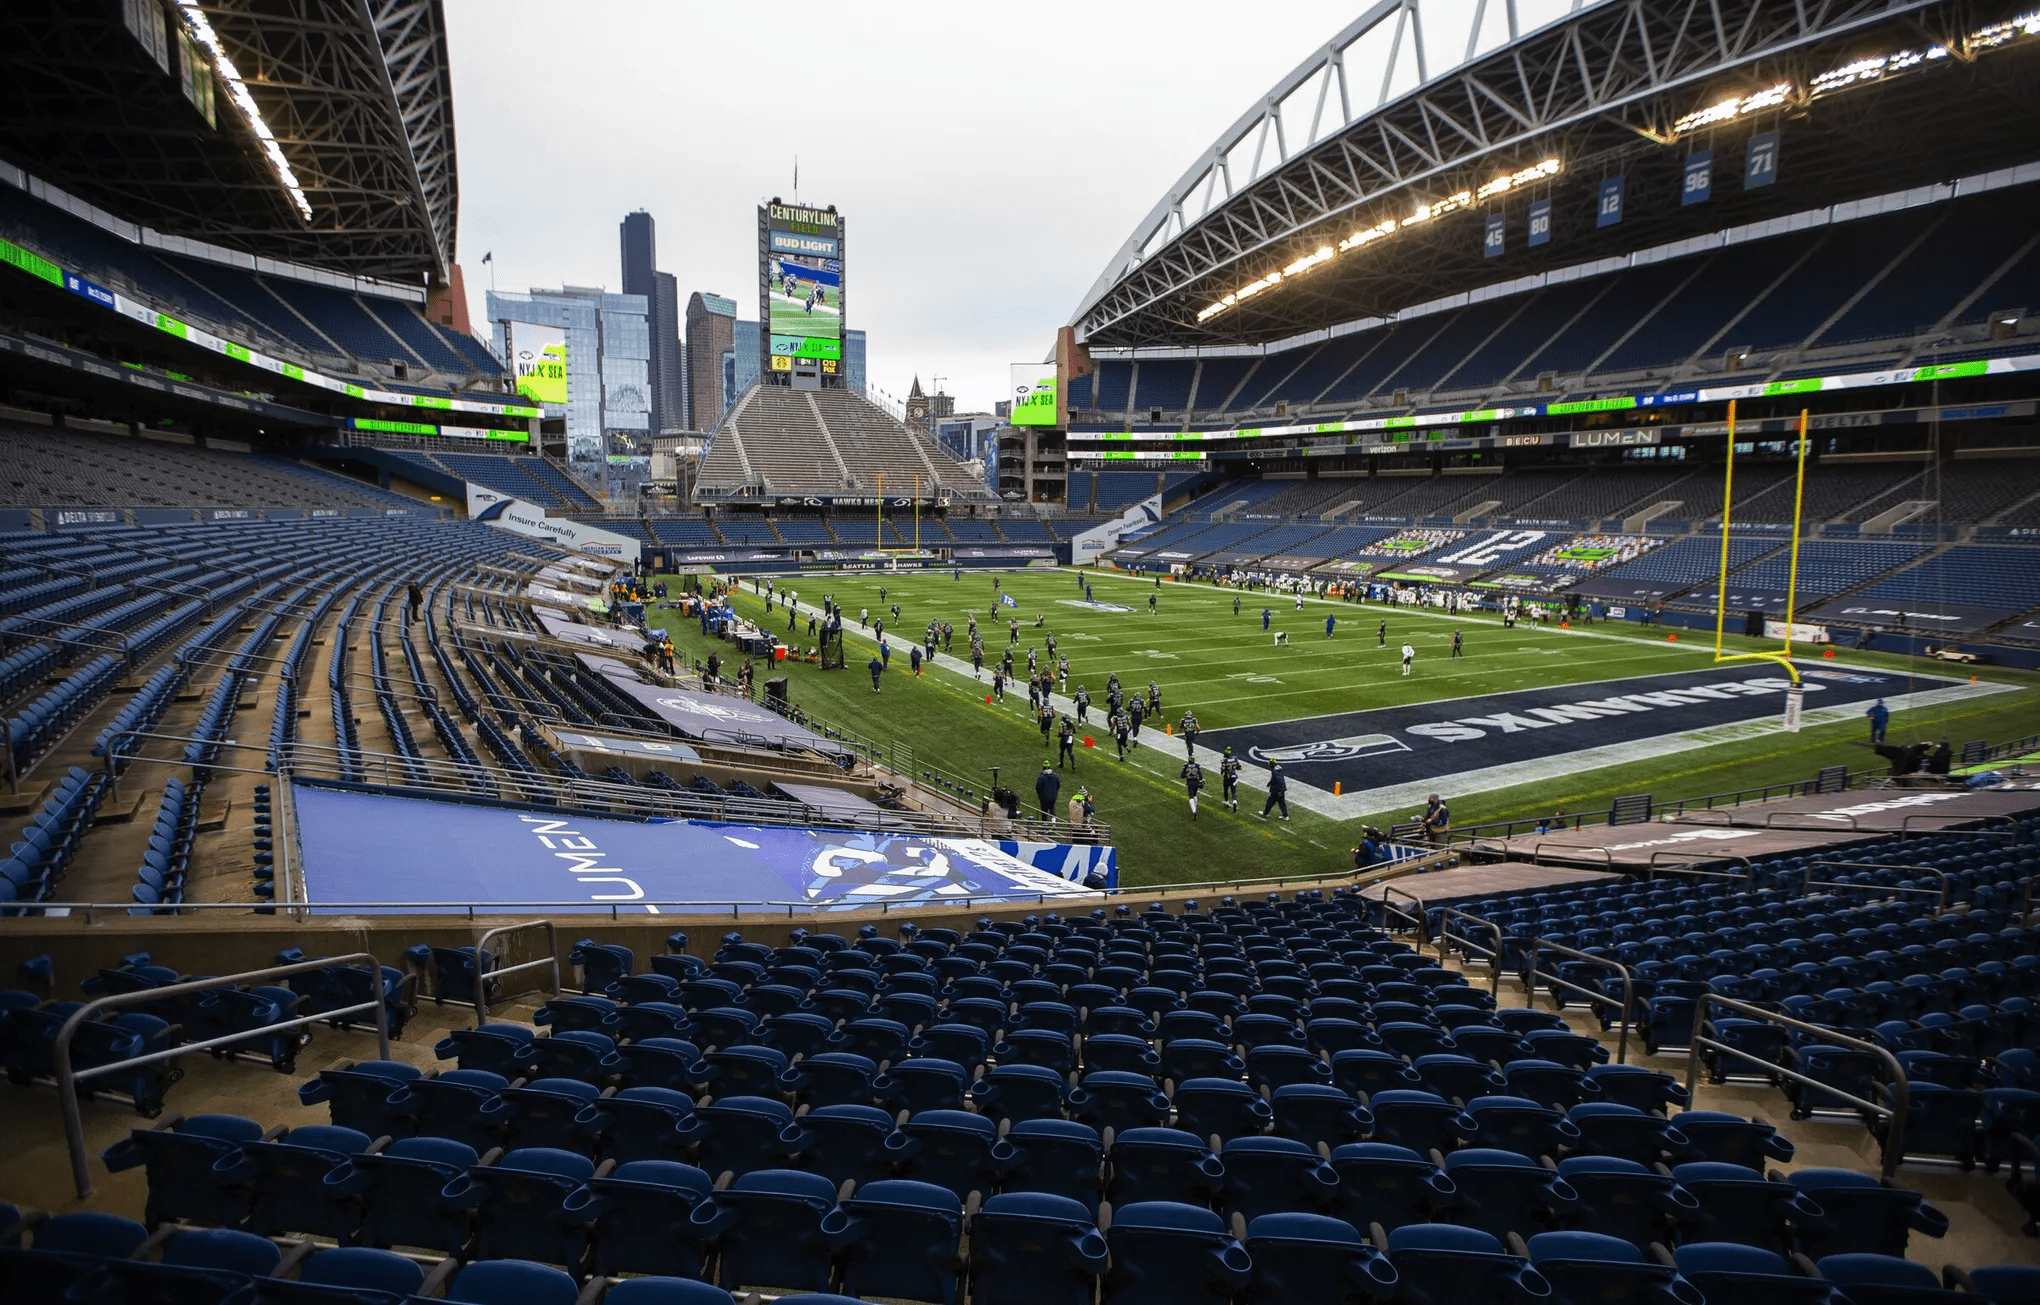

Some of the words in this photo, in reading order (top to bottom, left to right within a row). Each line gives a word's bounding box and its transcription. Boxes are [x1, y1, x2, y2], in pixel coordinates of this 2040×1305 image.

[1750, 151, 1773, 176] 71
[1684, 169, 1710, 193] 96
[1601, 194, 1620, 215] 12
[770, 203, 838, 227] CENTURYLINK
[1531, 215, 1549, 235] 80
[774, 236, 799, 249] BUD
[800, 239, 834, 253] LIGHT
[1485, 228, 1504, 247] 45
[519, 362, 535, 377] NYJ
[548, 364, 564, 379] SEA
[1015, 395, 1030, 407] NYJ
[1040, 394, 1054, 406] SEA
[1811, 414, 1873, 429] DELTA
[1576, 429, 1653, 447] LUMEN
[1369, 445, 1397, 454] verizon
[832, 498, 862, 506] HAWKS
[864, 498, 885, 506] NEST
[65, 511, 87, 524] DELTA
[508, 512, 537, 528] Insure
[538, 521, 577, 540] Carefully
[1107, 526, 1123, 537] Dream
[1123, 516, 1146, 532] Fearlessly
[1436, 530, 1546, 566] 12
[1405, 677, 1828, 743] SEAHAWKS
[520, 817, 660, 914] UMEN
